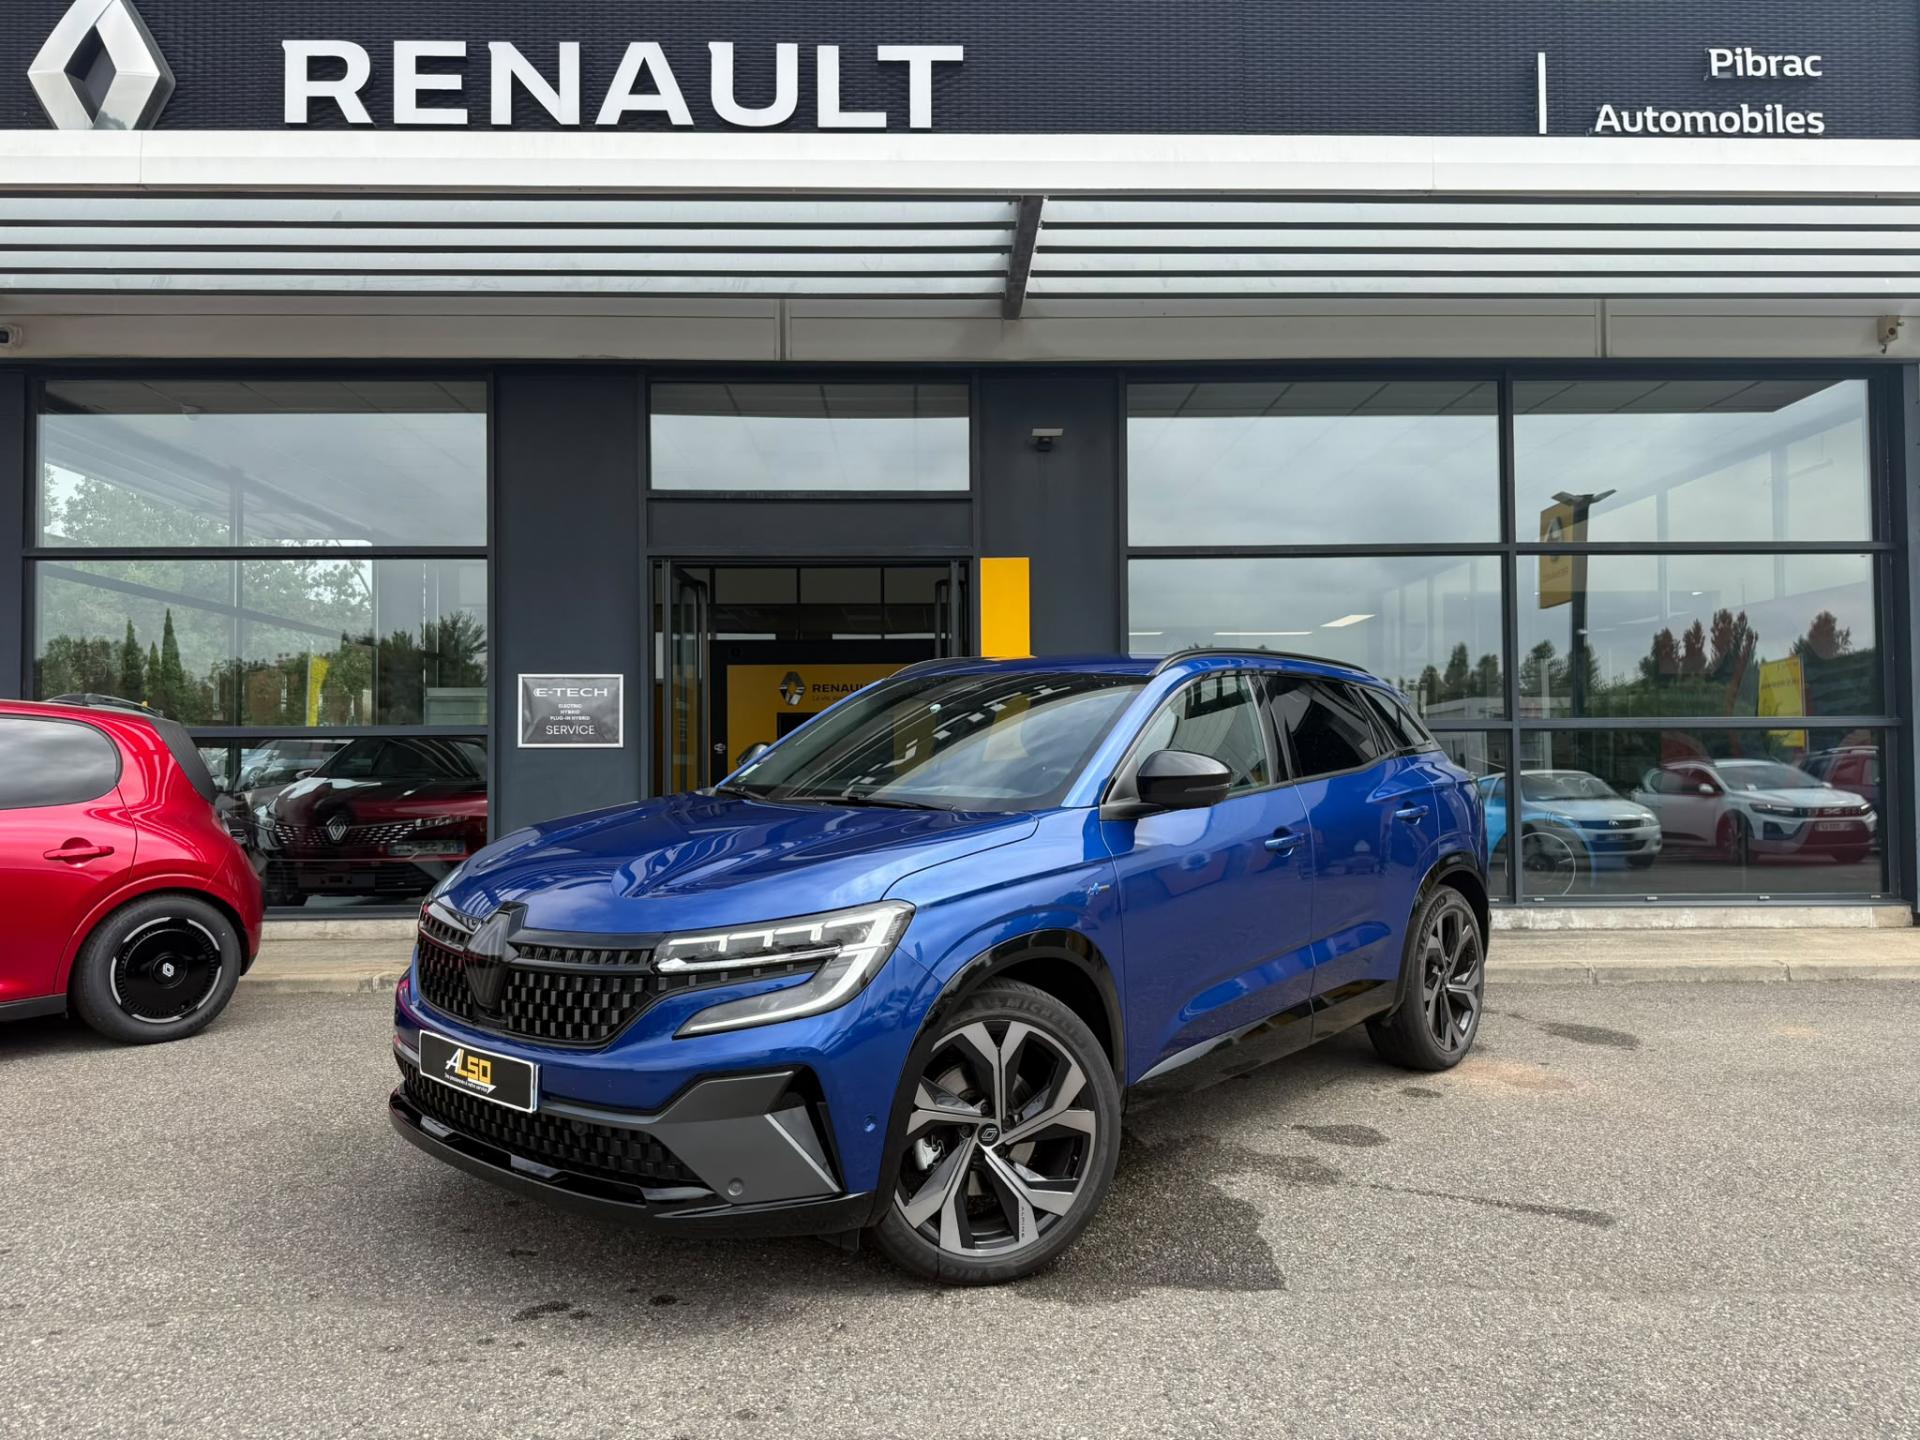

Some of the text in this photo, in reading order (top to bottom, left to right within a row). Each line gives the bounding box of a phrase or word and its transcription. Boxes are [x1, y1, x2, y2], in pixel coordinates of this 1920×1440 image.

[1708, 47, 1823, 78] Pibrac
[282, 40, 964, 129] RENAULT
[1594, 103, 1826, 135] Automobiles
[533, 687, 608, 697] E-TECH
[812, 683, 866, 693] RENAU
[545, 725, 595, 735] SERVICE
